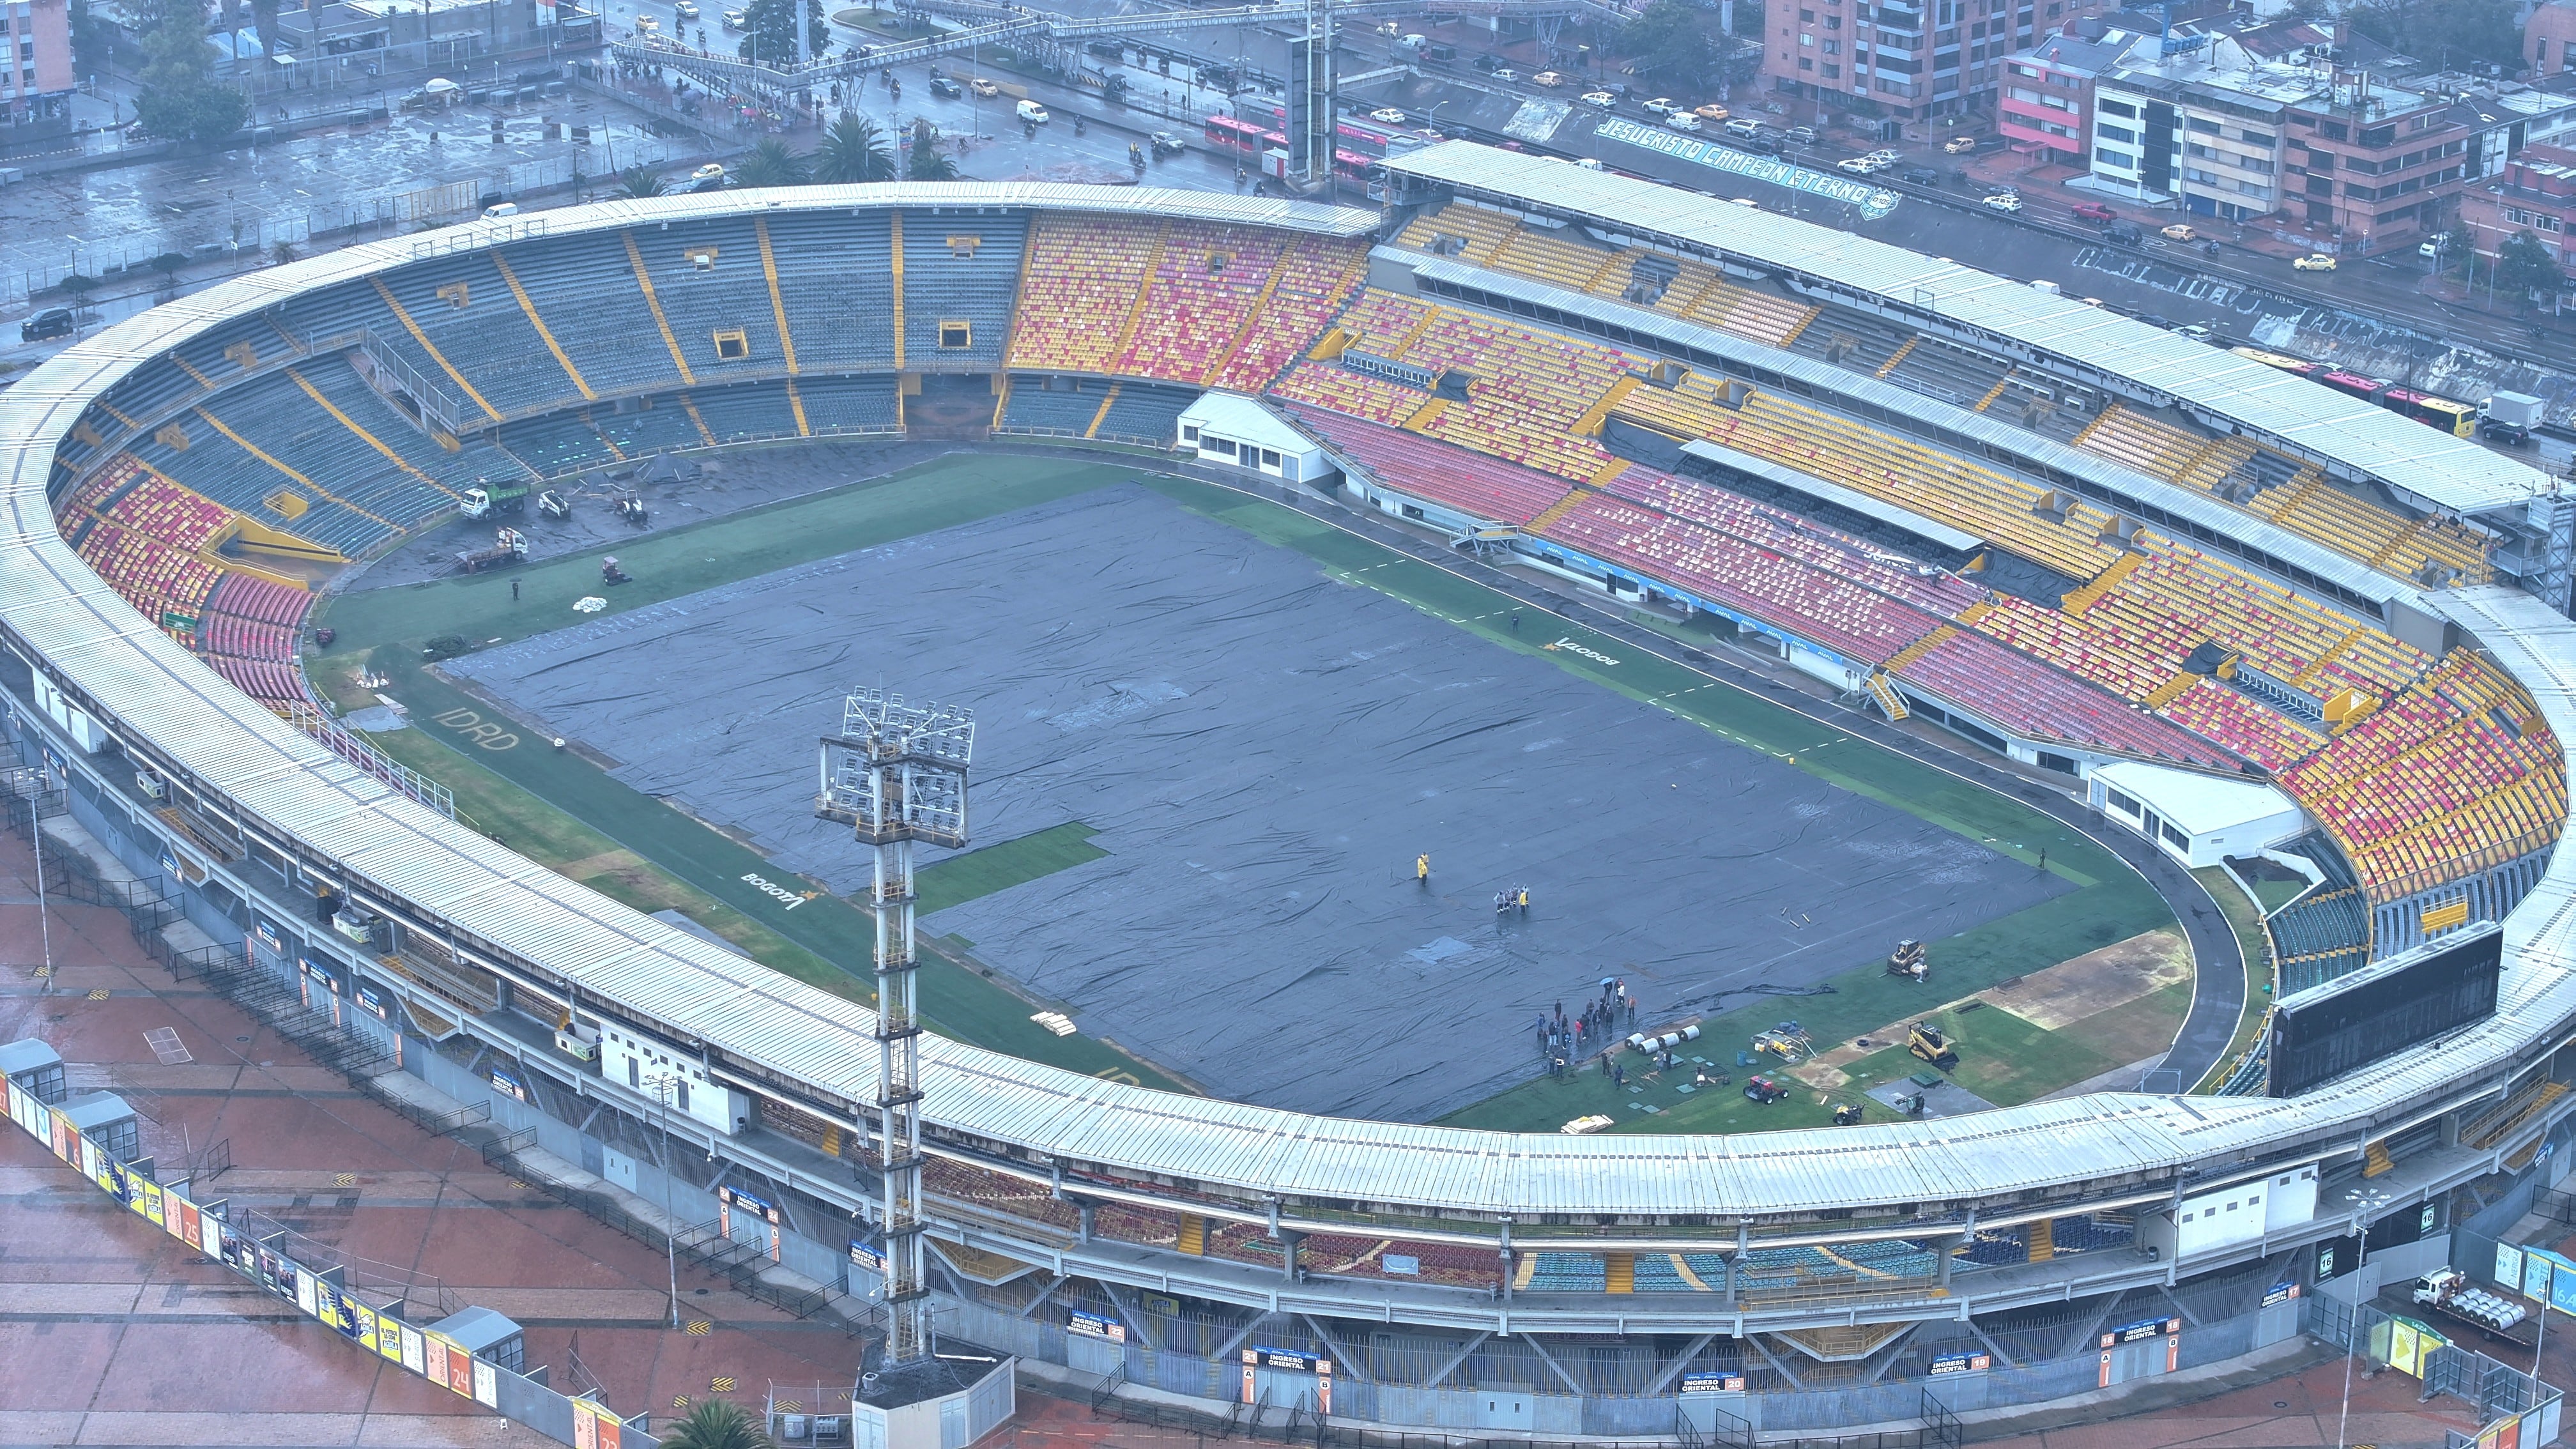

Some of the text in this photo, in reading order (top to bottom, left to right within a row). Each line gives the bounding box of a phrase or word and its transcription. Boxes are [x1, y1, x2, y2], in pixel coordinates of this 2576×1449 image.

[1597, 119, 1705, 160] JESUCRISTO
[1787, 169, 1871, 203] ETERNO
[1546, 546, 1690, 602] AVAL AVAL AVAL AVAL AVAL AVAL
[1715, 609, 1833, 661] AVAL AVAL AVAL AVAL AVAL
[431, 700, 519, 750] IDRD
[720, 1190, 729, 1199] 24
[737, 1195, 760, 1209] INGRESO
[769, 1211, 778, 1220] 24
[736, 1200, 762, 1215] ORIENTAL
[2423, 1213, 2432, 1223] 16
[185, 1221, 198, 1242] 25
[851, 1252, 878, 1267] ORIENTAL
[852, 1246, 876, 1261] INGRESO
[2321, 1257, 2331, 1268] 16
[2262, 1295, 2287, 1307] ORIENTAL
[2264, 1287, 2299, 1301] INGRESO 17
[1071, 1322, 1123, 1336] ORIENTAL 22
[1072, 1317, 1103, 1328] INGRESO
[2411, 1321, 2427, 1333] SALIDA
[2102, 1336, 2113, 1344] 18
[2126, 1324, 2156, 1335] INGRESO
[2167, 1321, 2178, 1330] 18
[2124, 1330, 2156, 1342] ORIENTAL
[1268, 1360, 1305, 1369] ORIENTAL
[1269, 1354, 1303, 1363] INGRESO
[1933, 1359, 1965, 1368] INGRESO
[1931, 1365, 1967, 1374] ORIENTAL
[453, 1368, 470, 1392] 24
